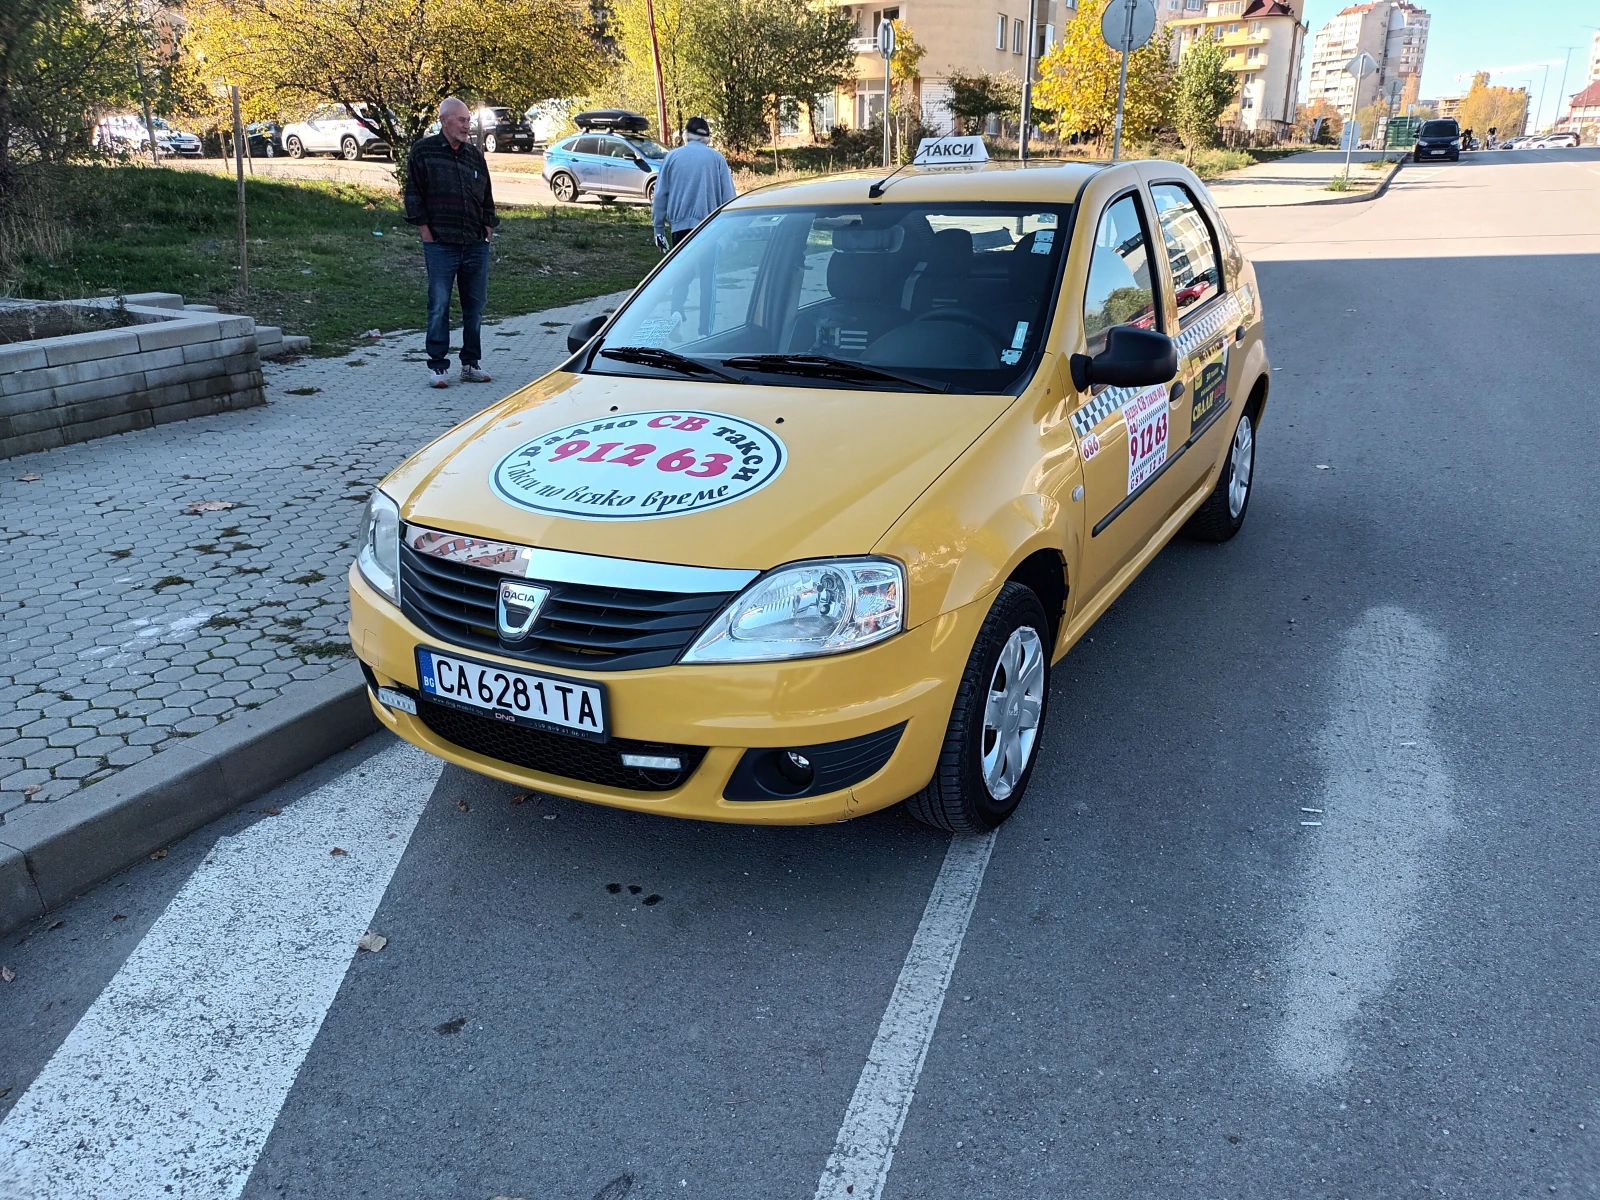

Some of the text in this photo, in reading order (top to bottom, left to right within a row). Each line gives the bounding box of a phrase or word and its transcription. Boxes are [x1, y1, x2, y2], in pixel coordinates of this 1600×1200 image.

[925, 143, 974, 156] ТАКСИ
[712, 425, 764, 482] такси
[1083, 437, 1099, 459] 686
[507, 460, 729, 512] Такси по всяко време
[503, 589, 536, 603] DACIA
[424, 675, 435, 688] BG
[495, 712, 516, 723] DNG
